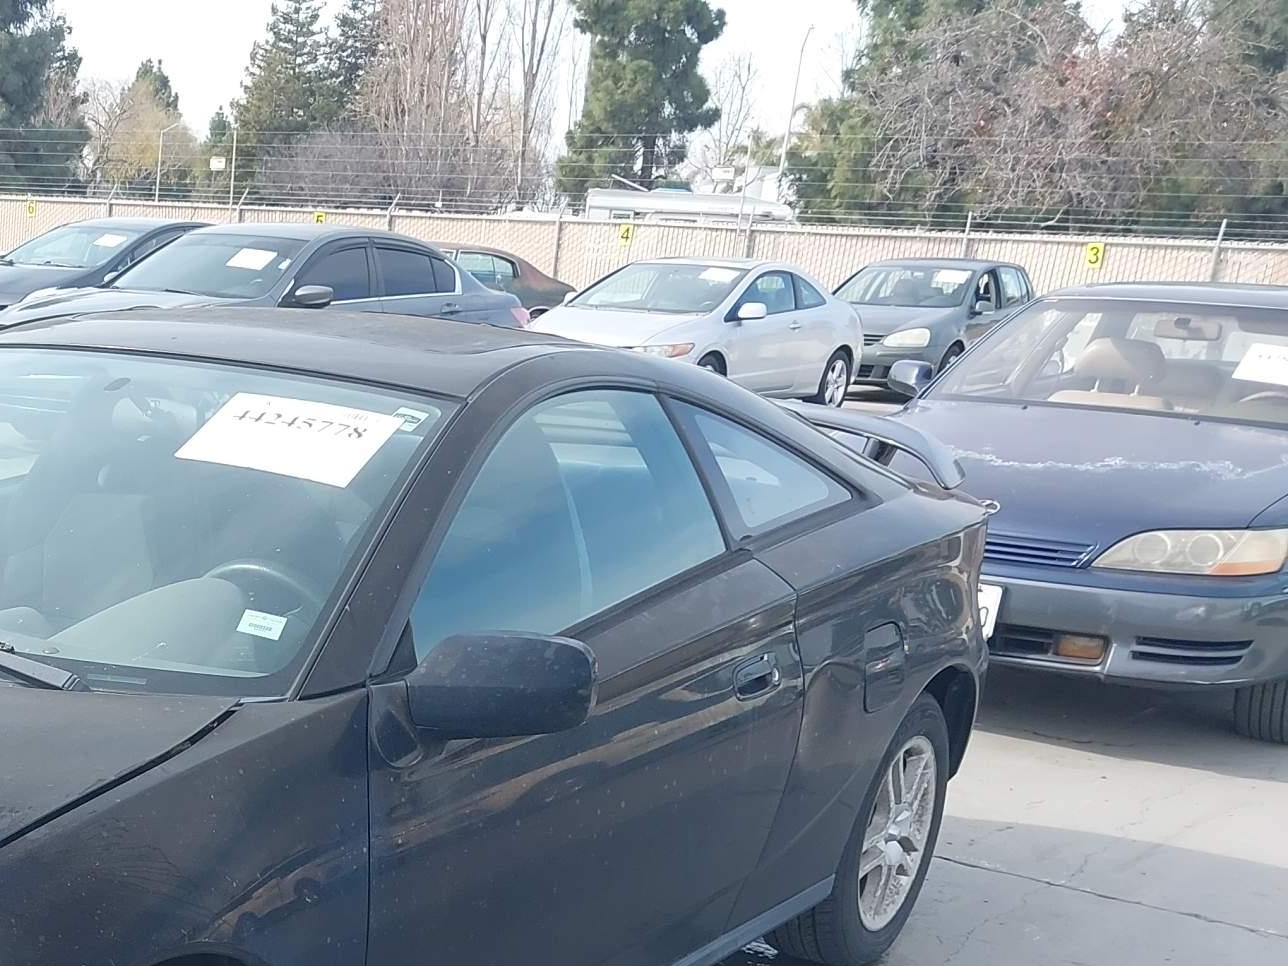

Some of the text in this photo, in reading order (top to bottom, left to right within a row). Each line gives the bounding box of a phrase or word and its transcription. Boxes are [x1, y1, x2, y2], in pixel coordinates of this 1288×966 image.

[28, 201, 34, 214] 6
[621, 227, 630, 242] 4
[1088, 246, 1100, 264] 3
[232, 410, 368, 440] 44245778
